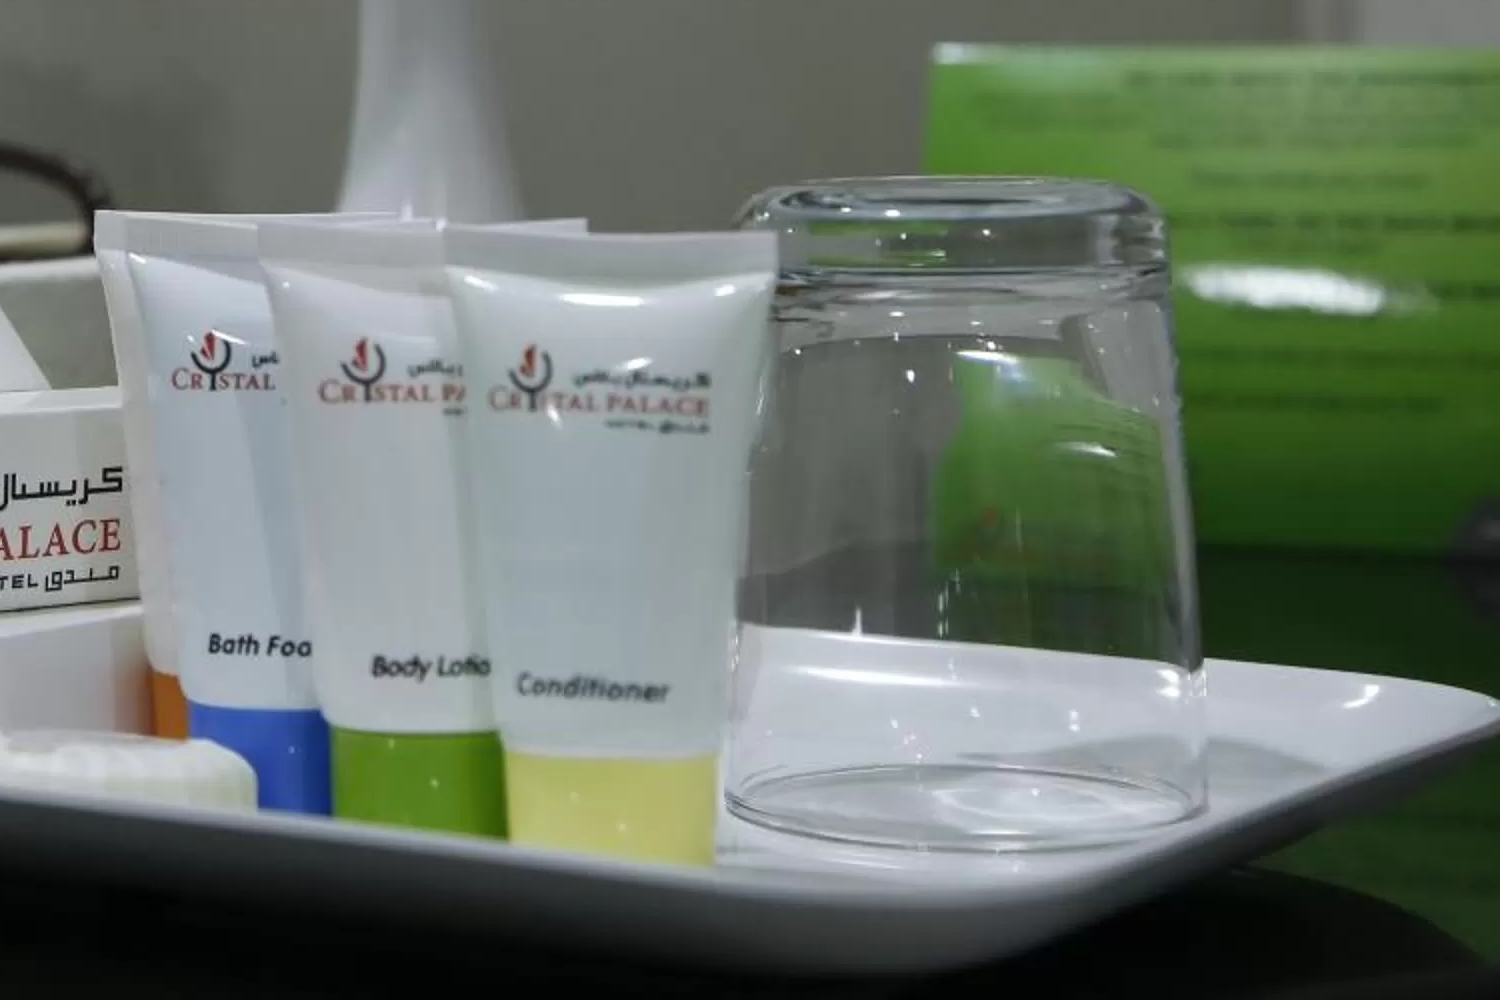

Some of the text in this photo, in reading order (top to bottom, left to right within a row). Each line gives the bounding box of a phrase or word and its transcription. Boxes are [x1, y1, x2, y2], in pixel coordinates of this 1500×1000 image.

[606, 392, 708, 416] PALACE
[208, 634, 311, 657] Bath Foa
[371, 656, 491, 683] Body Lotio
[517, 672, 669, 702] Conditioner
